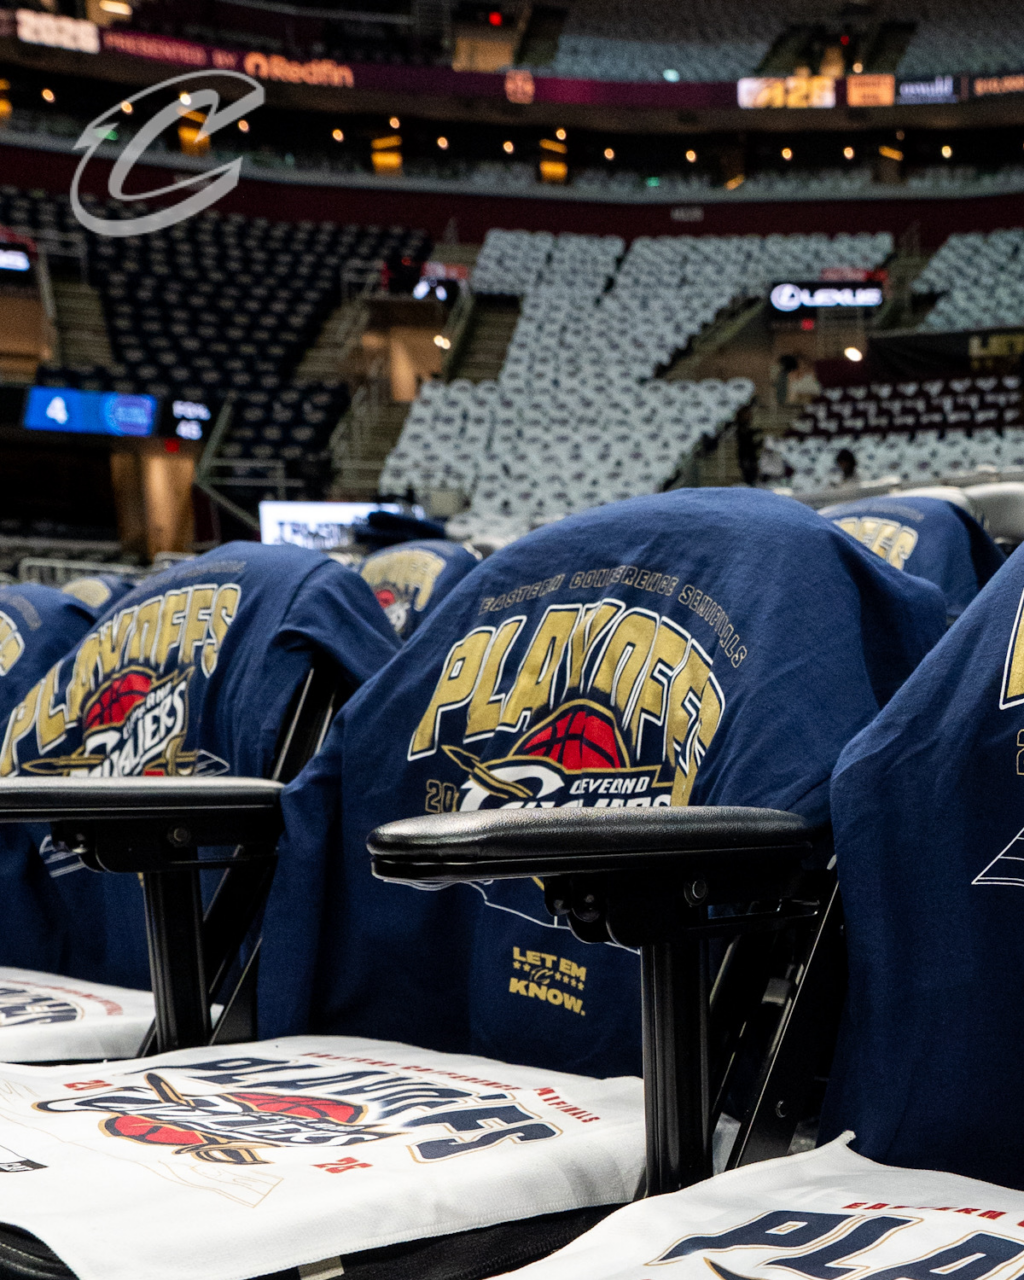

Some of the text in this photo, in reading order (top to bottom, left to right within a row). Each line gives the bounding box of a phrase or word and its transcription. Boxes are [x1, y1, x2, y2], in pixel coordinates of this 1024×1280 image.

[801, 288, 882, 307] LEXUS
[513, 946, 597, 981] LET EM
[509, 977, 586, 1016] KNOW.
